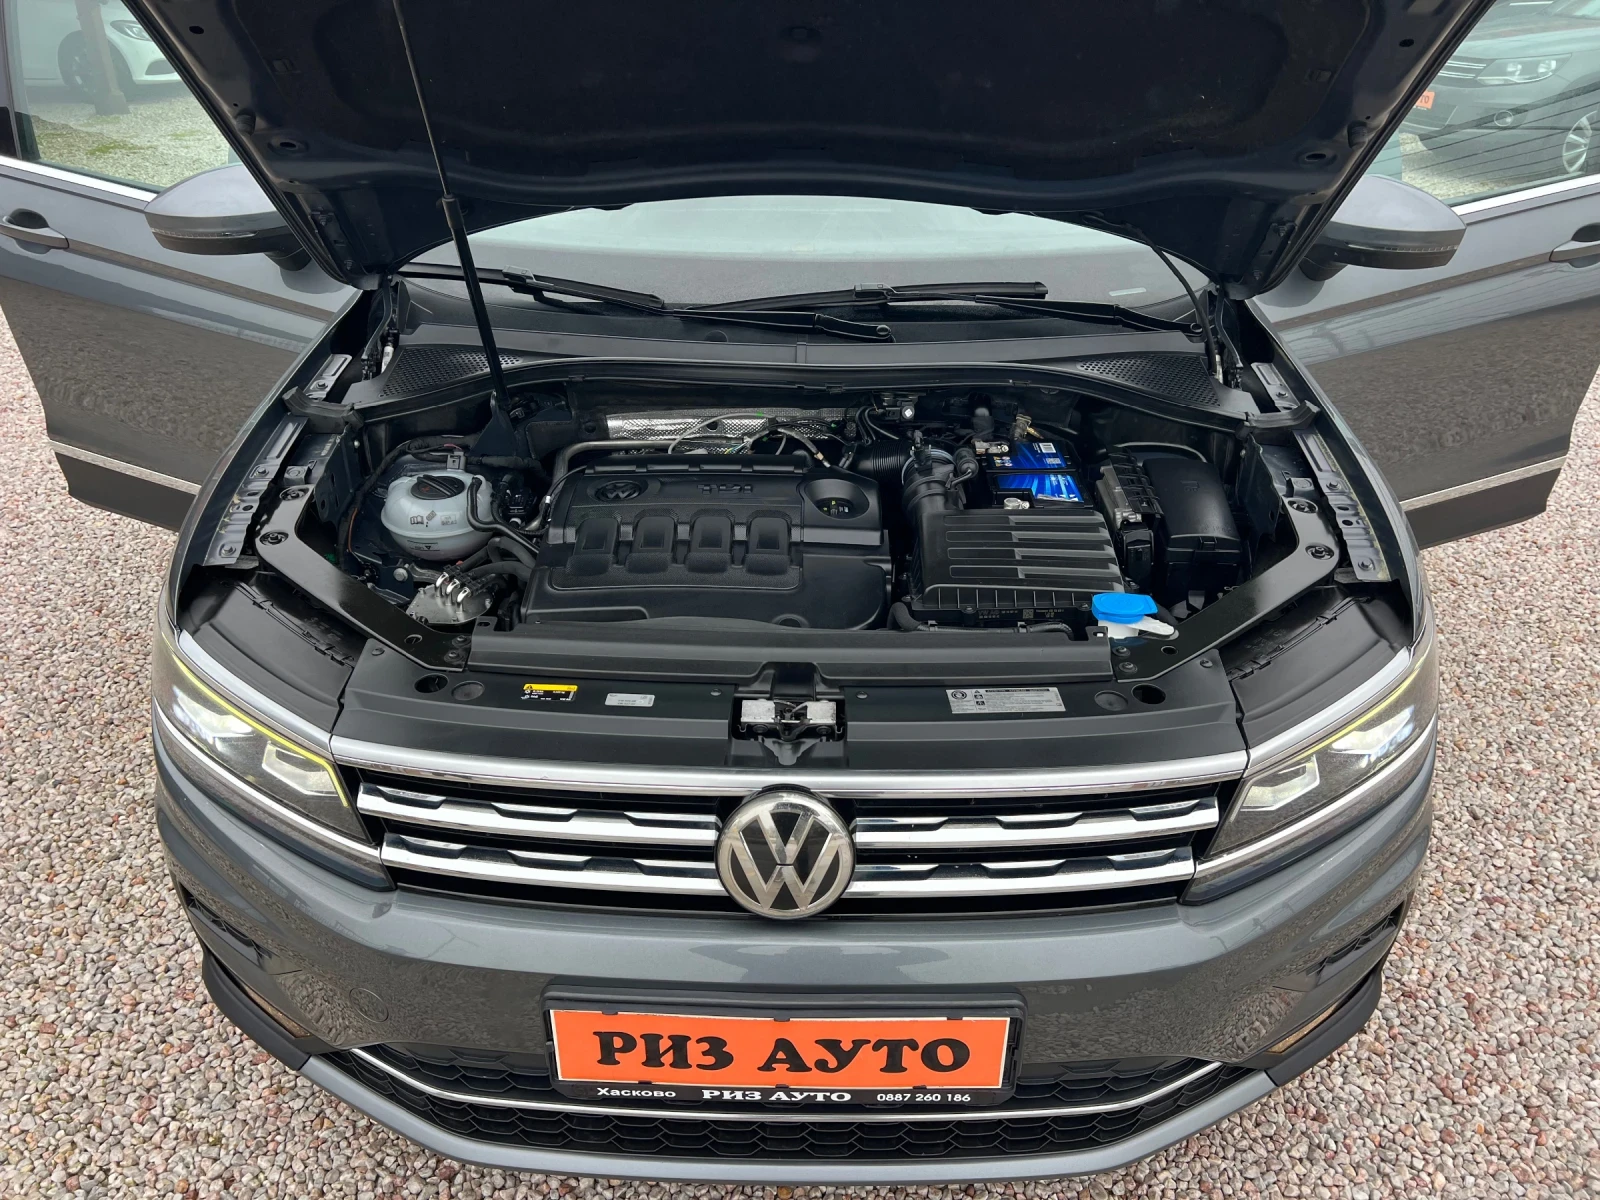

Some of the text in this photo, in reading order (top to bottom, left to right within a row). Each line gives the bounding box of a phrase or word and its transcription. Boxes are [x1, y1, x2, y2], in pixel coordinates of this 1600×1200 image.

[697, 483, 753, 496] TDI
[719, 798, 851, 916] VW
[593, 1031, 971, 1073] РИЗ АУТО
[596, 1087, 971, 1102] Хасково РИЗ АУТО 0887 260 186
